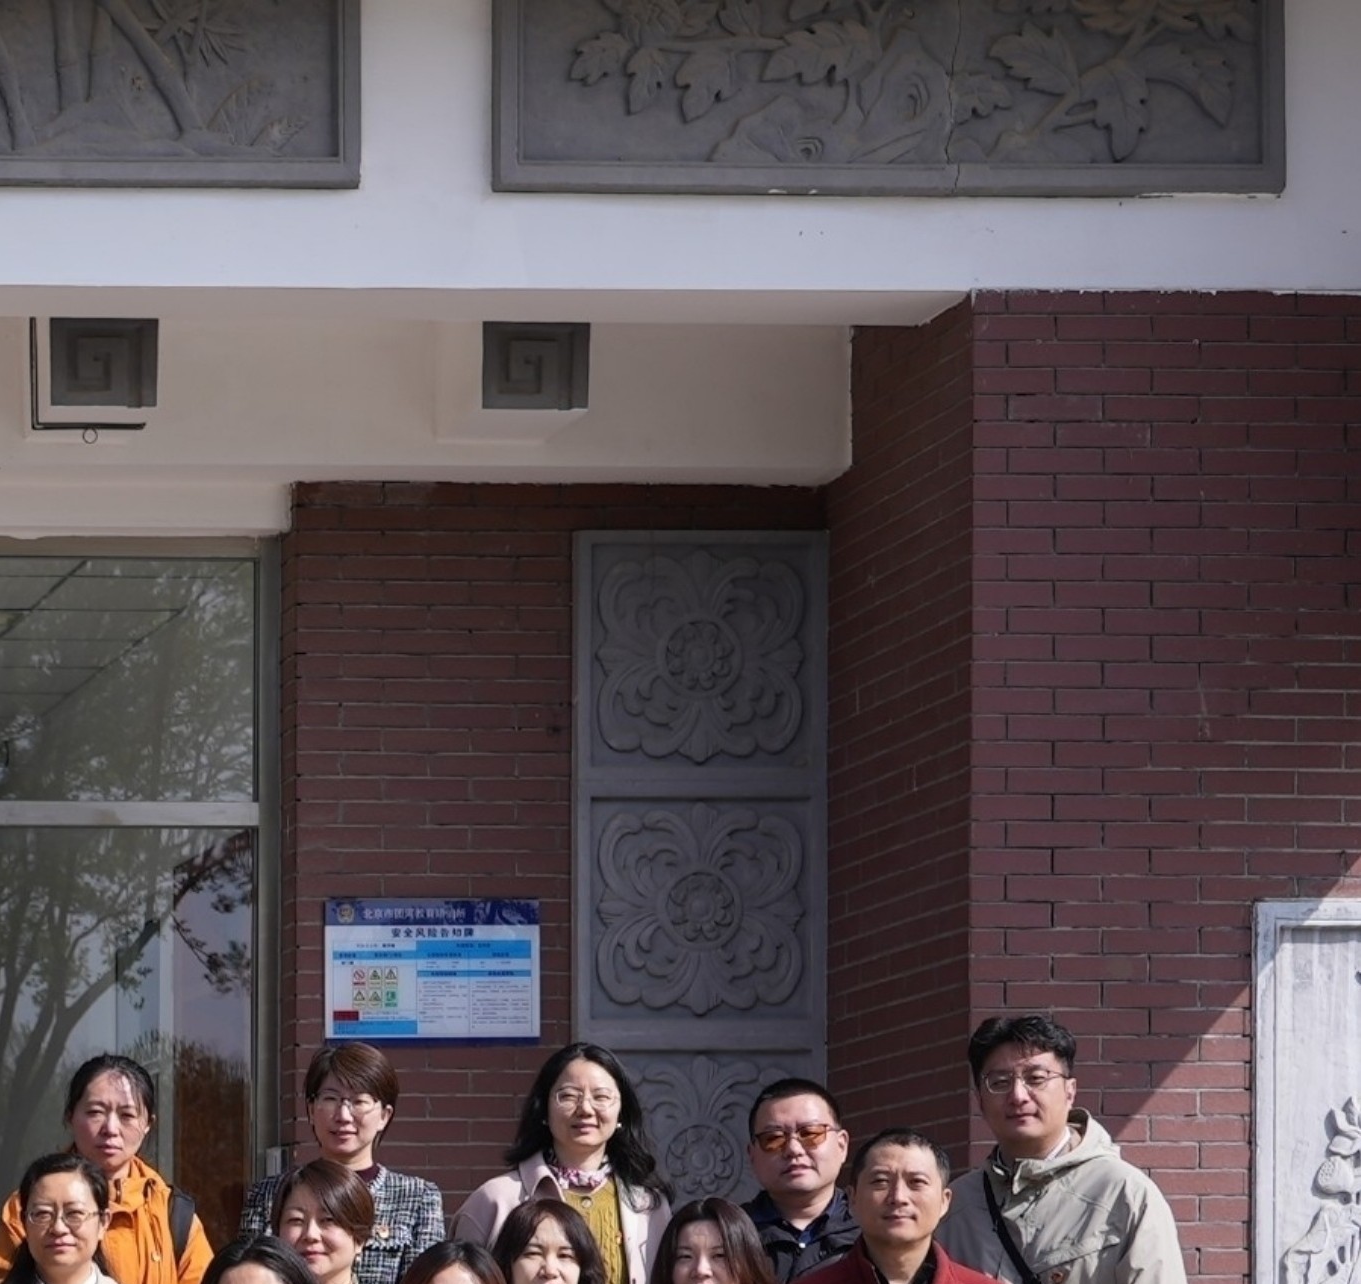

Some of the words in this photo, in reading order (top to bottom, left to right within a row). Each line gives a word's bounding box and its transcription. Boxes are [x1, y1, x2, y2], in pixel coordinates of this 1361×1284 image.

[390, 927, 475, 938] 安全风险告知牌
